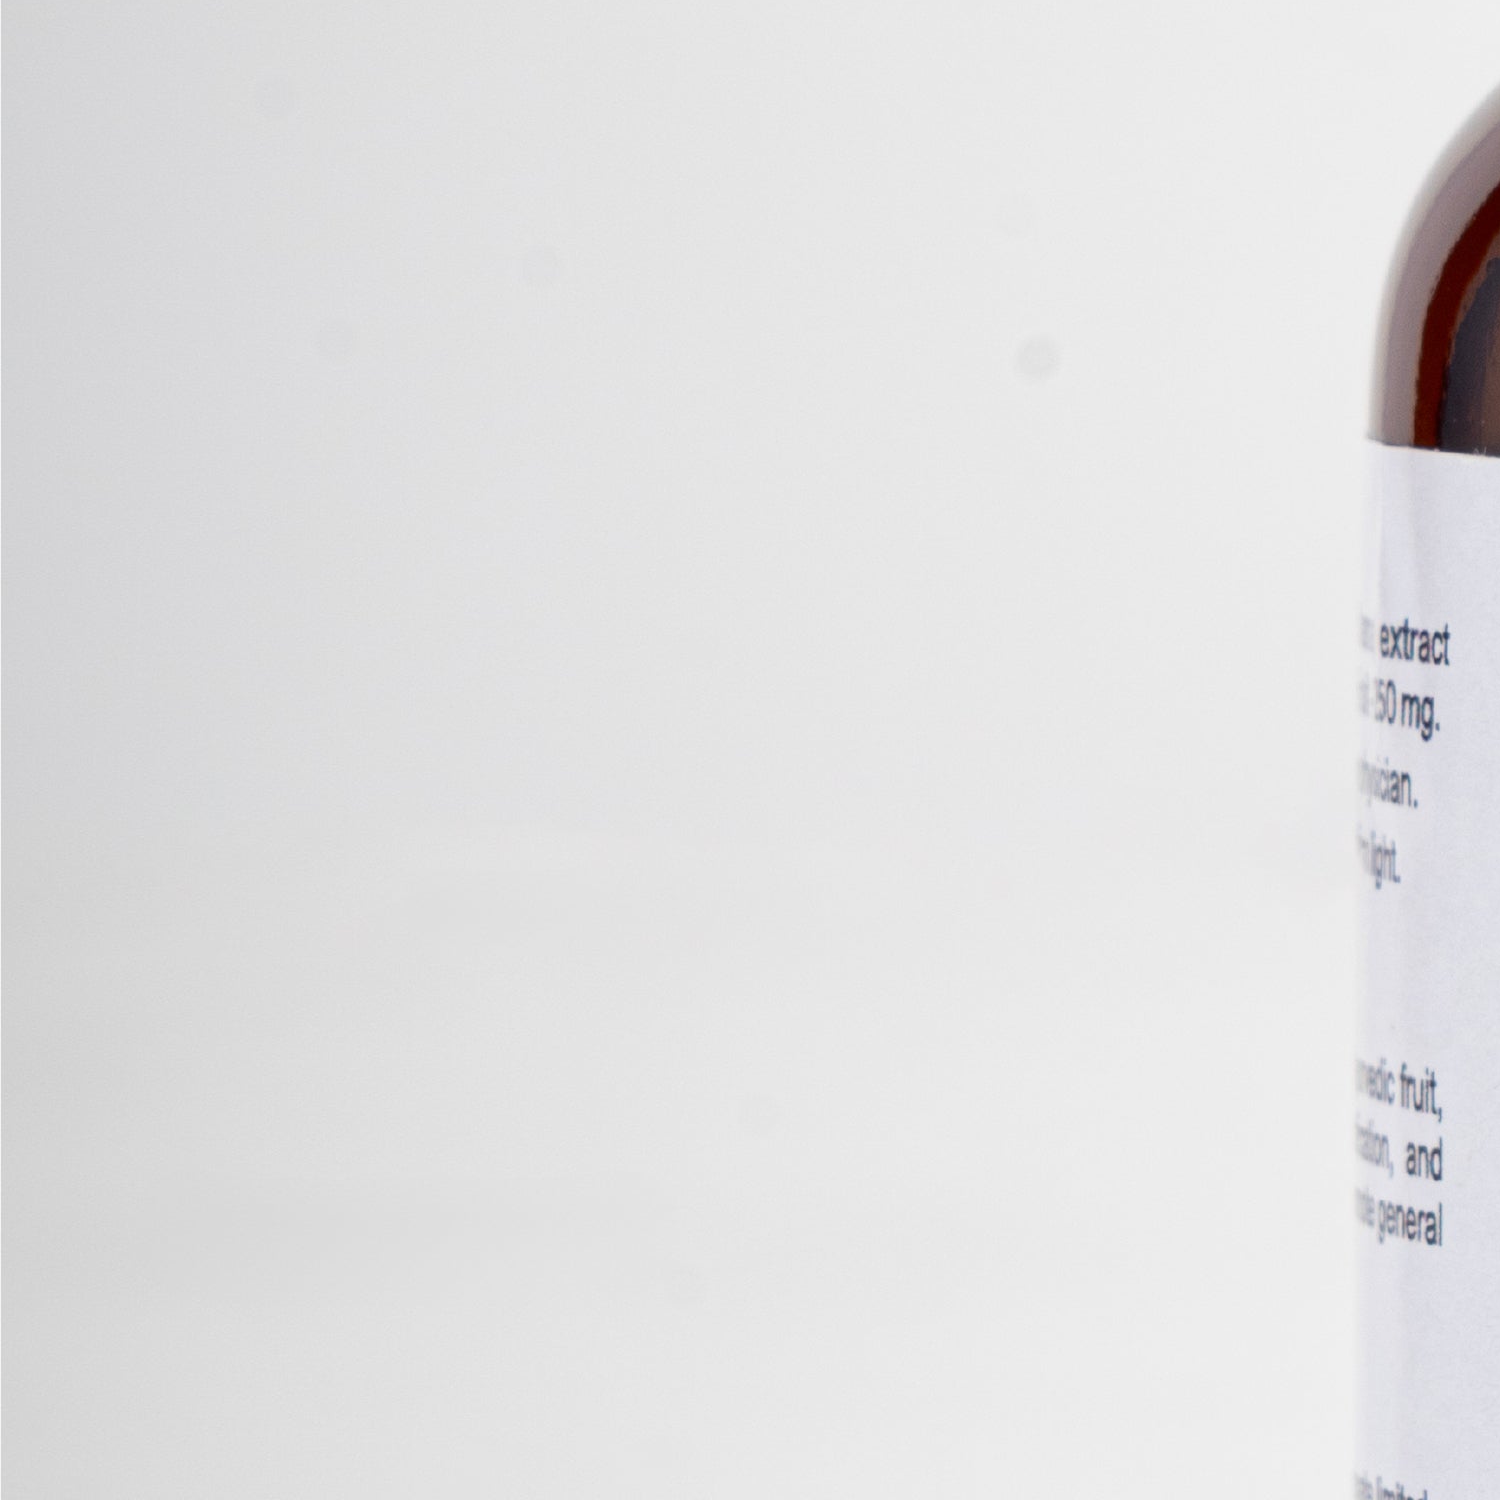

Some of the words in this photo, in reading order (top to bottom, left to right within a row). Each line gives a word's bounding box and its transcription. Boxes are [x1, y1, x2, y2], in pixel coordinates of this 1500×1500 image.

[1380, 618, 1450, 666] extract
[1401, 693, 1440, 742] mg.
[1400, 1062, 1442, 1123] fruit,
[1406, 1136, 1443, 1181] and
[1378, 1199, 1442, 1246] general
